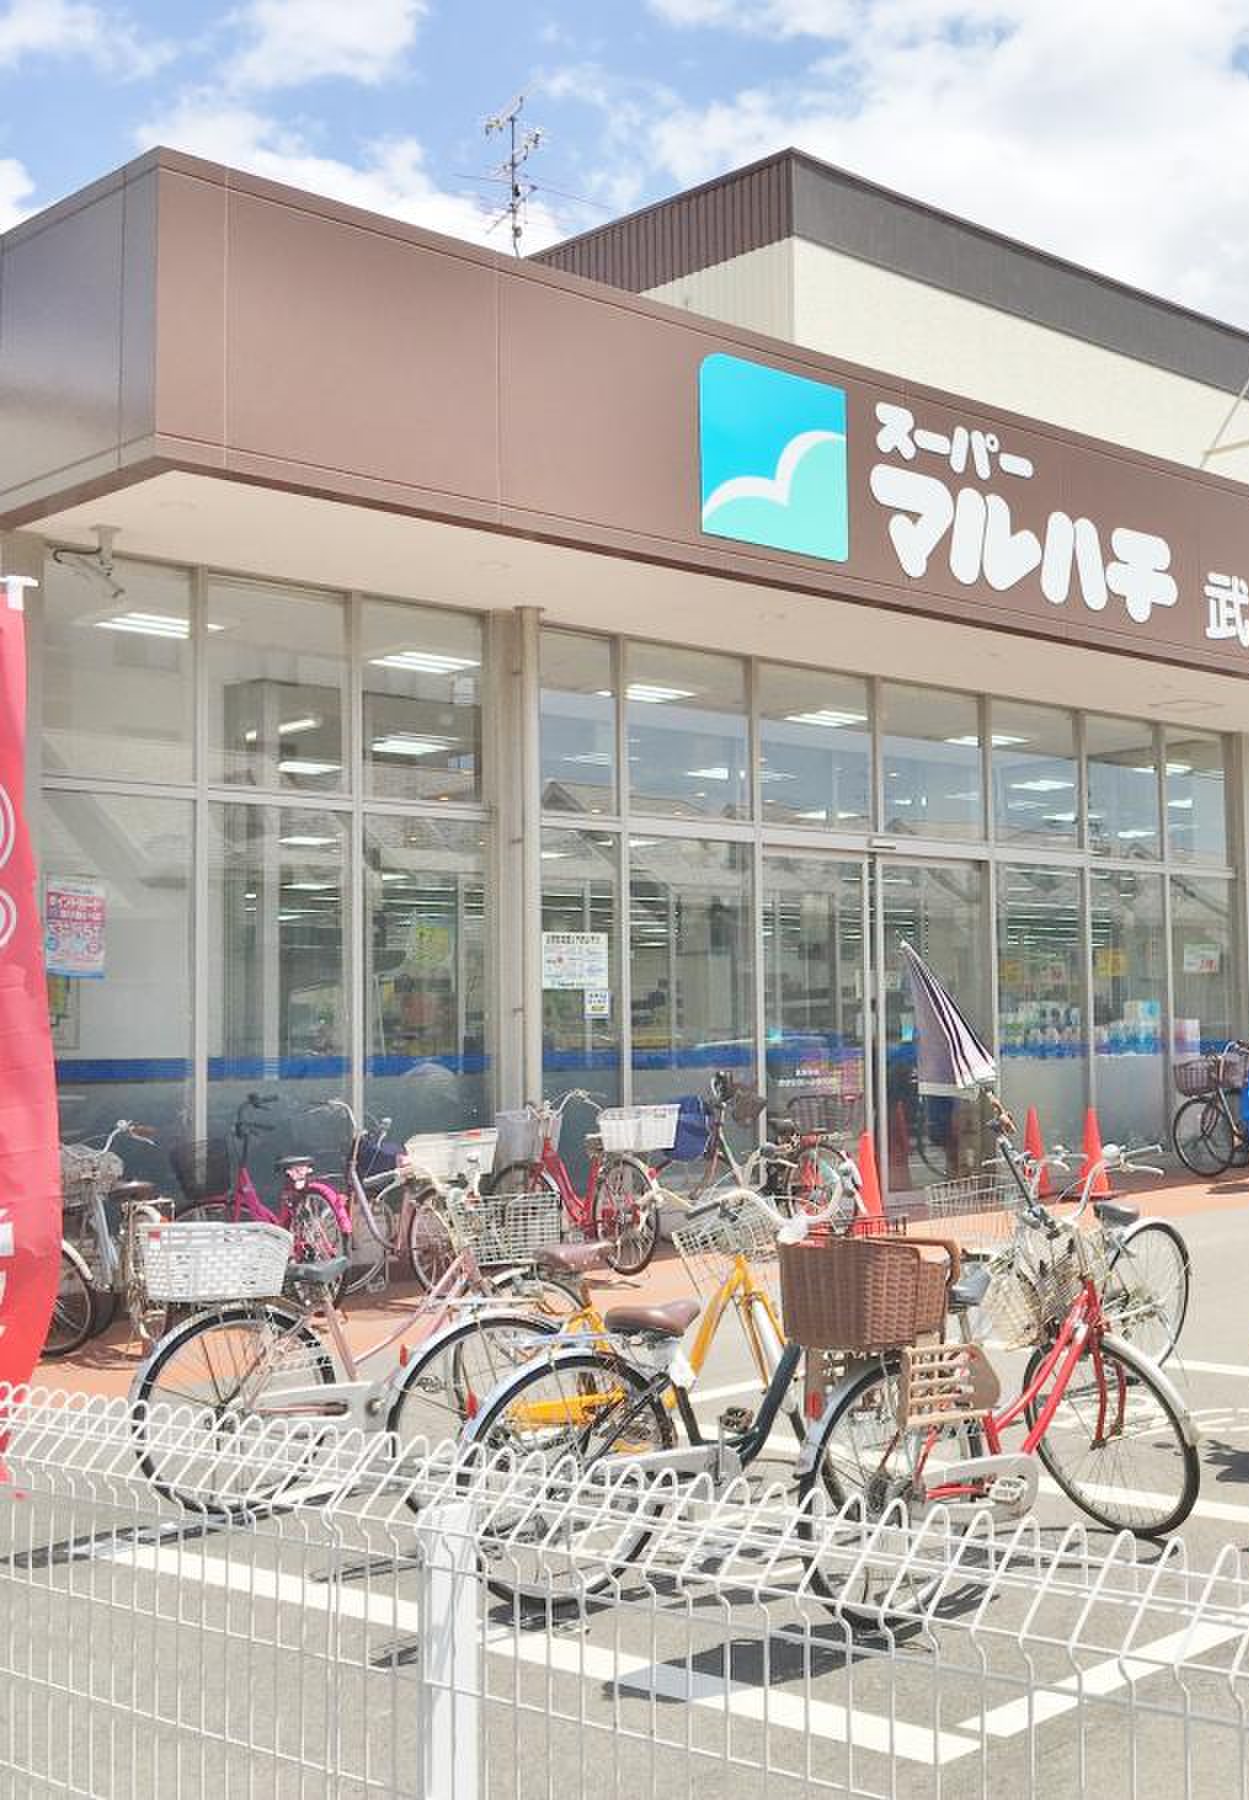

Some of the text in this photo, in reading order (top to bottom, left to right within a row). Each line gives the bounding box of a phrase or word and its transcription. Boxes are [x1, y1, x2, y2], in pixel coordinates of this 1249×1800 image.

[874, 401, 1034, 479] スーパー
[869, 463, 1178, 623] マルハチ
